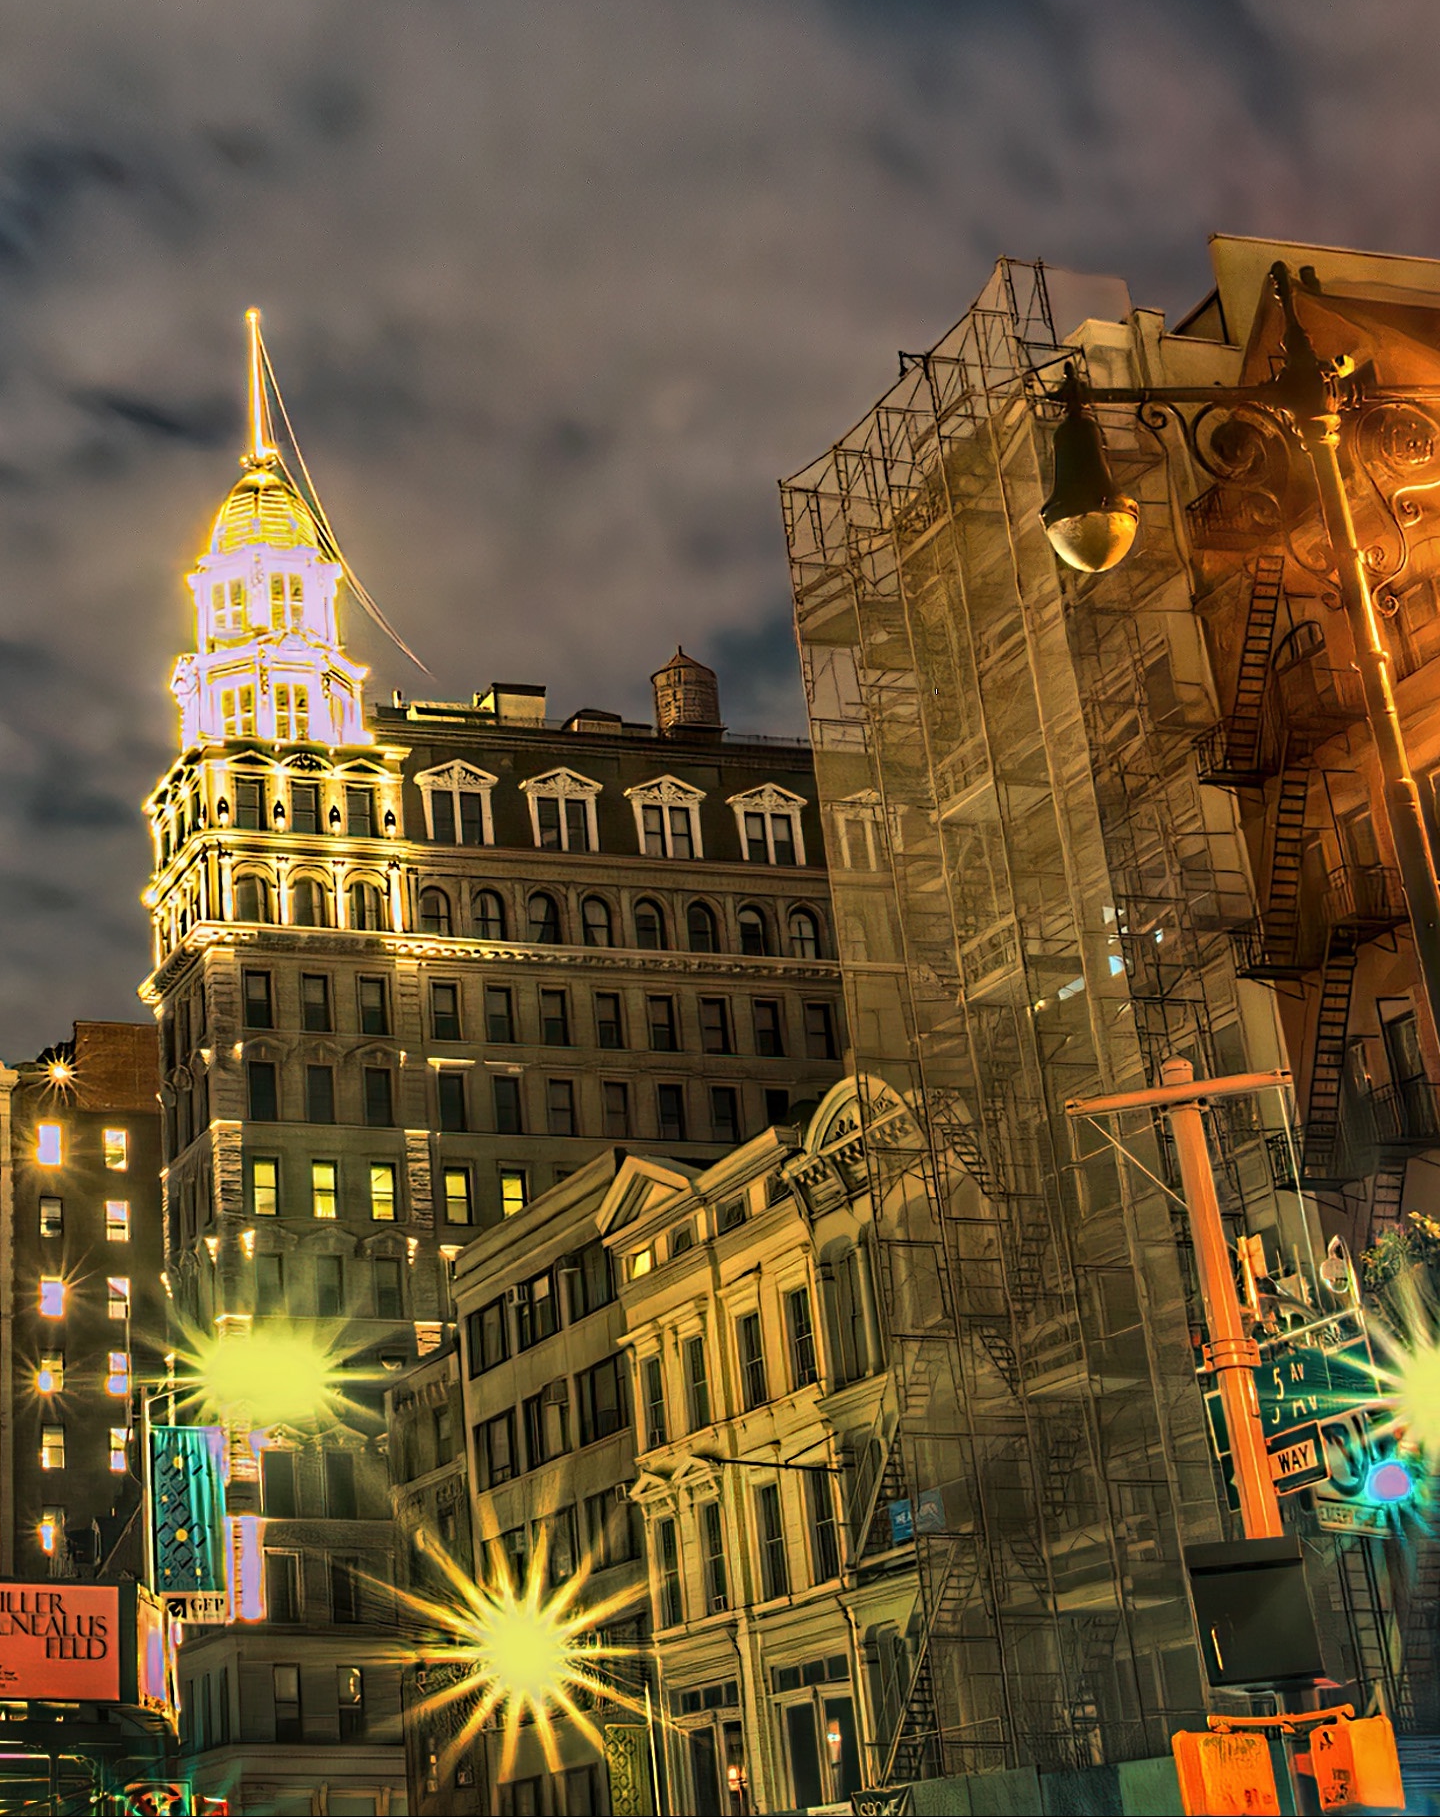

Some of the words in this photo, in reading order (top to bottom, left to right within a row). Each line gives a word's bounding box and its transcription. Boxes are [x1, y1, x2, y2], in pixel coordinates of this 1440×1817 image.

[1272, 1367, 1285, 1401] 5
[1277, 1444, 1309, 1474] WAY
[46, 1637, 108, 1659] FELD
